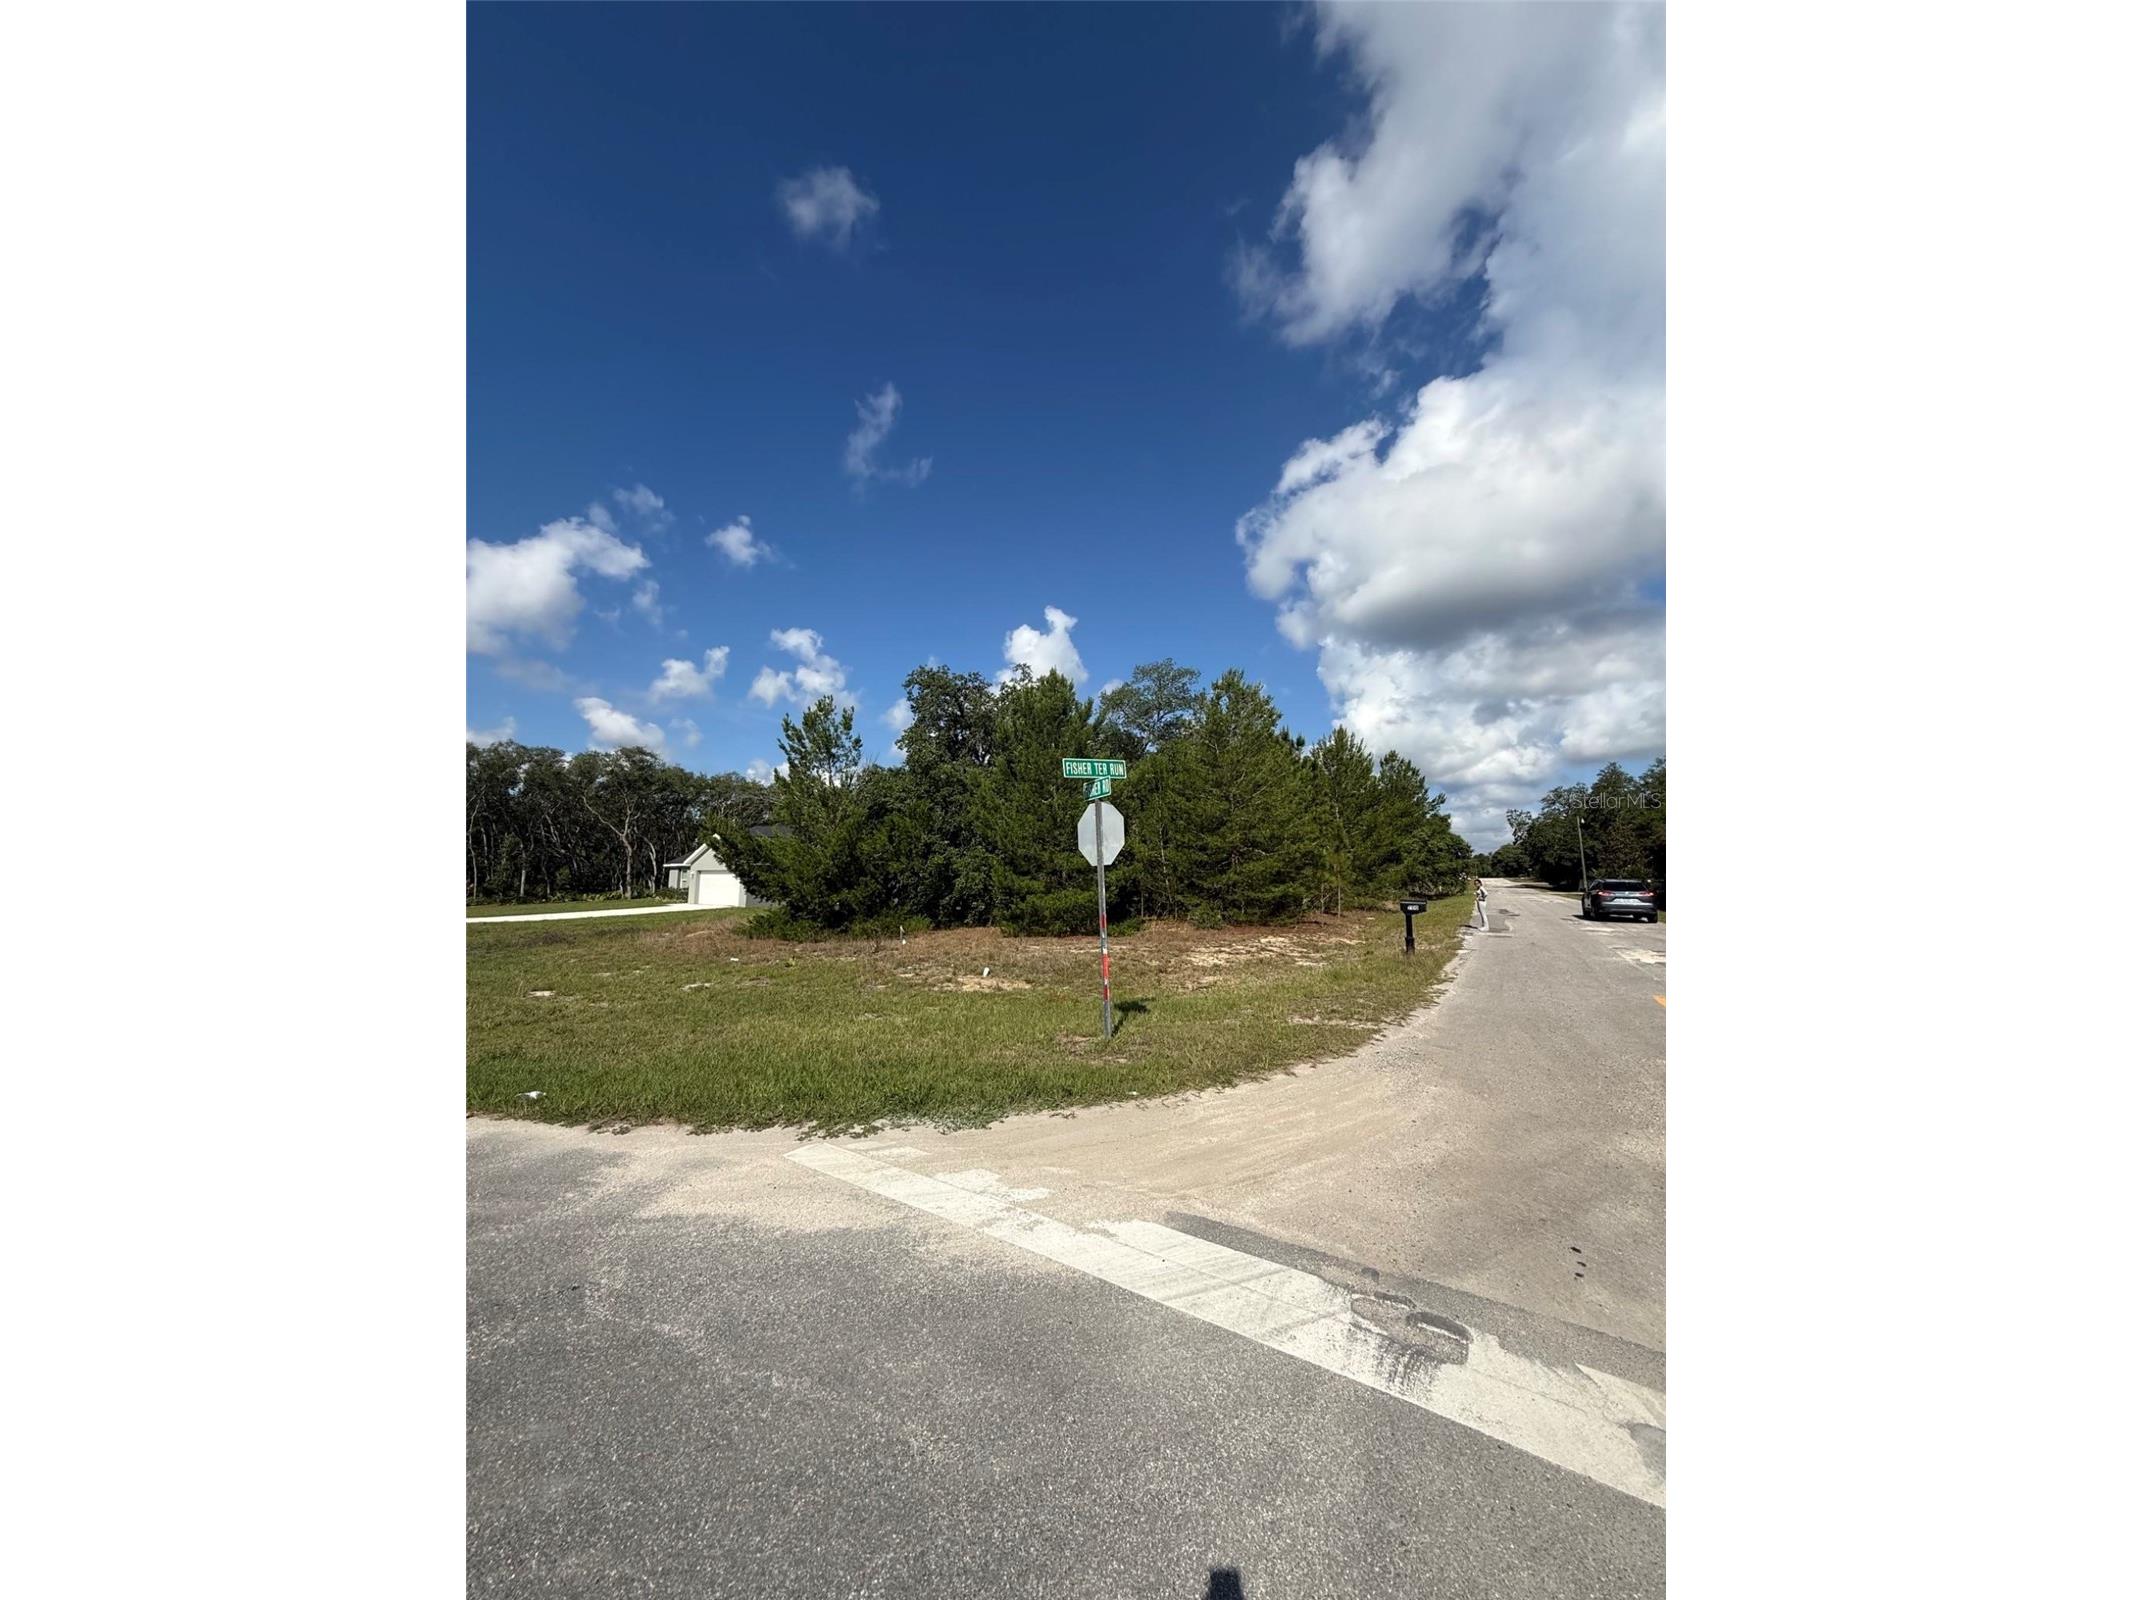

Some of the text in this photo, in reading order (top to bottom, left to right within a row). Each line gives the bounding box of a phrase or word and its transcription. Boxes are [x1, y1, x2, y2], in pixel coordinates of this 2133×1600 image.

[1065, 761, 1124, 776] FISHER TER RUN
